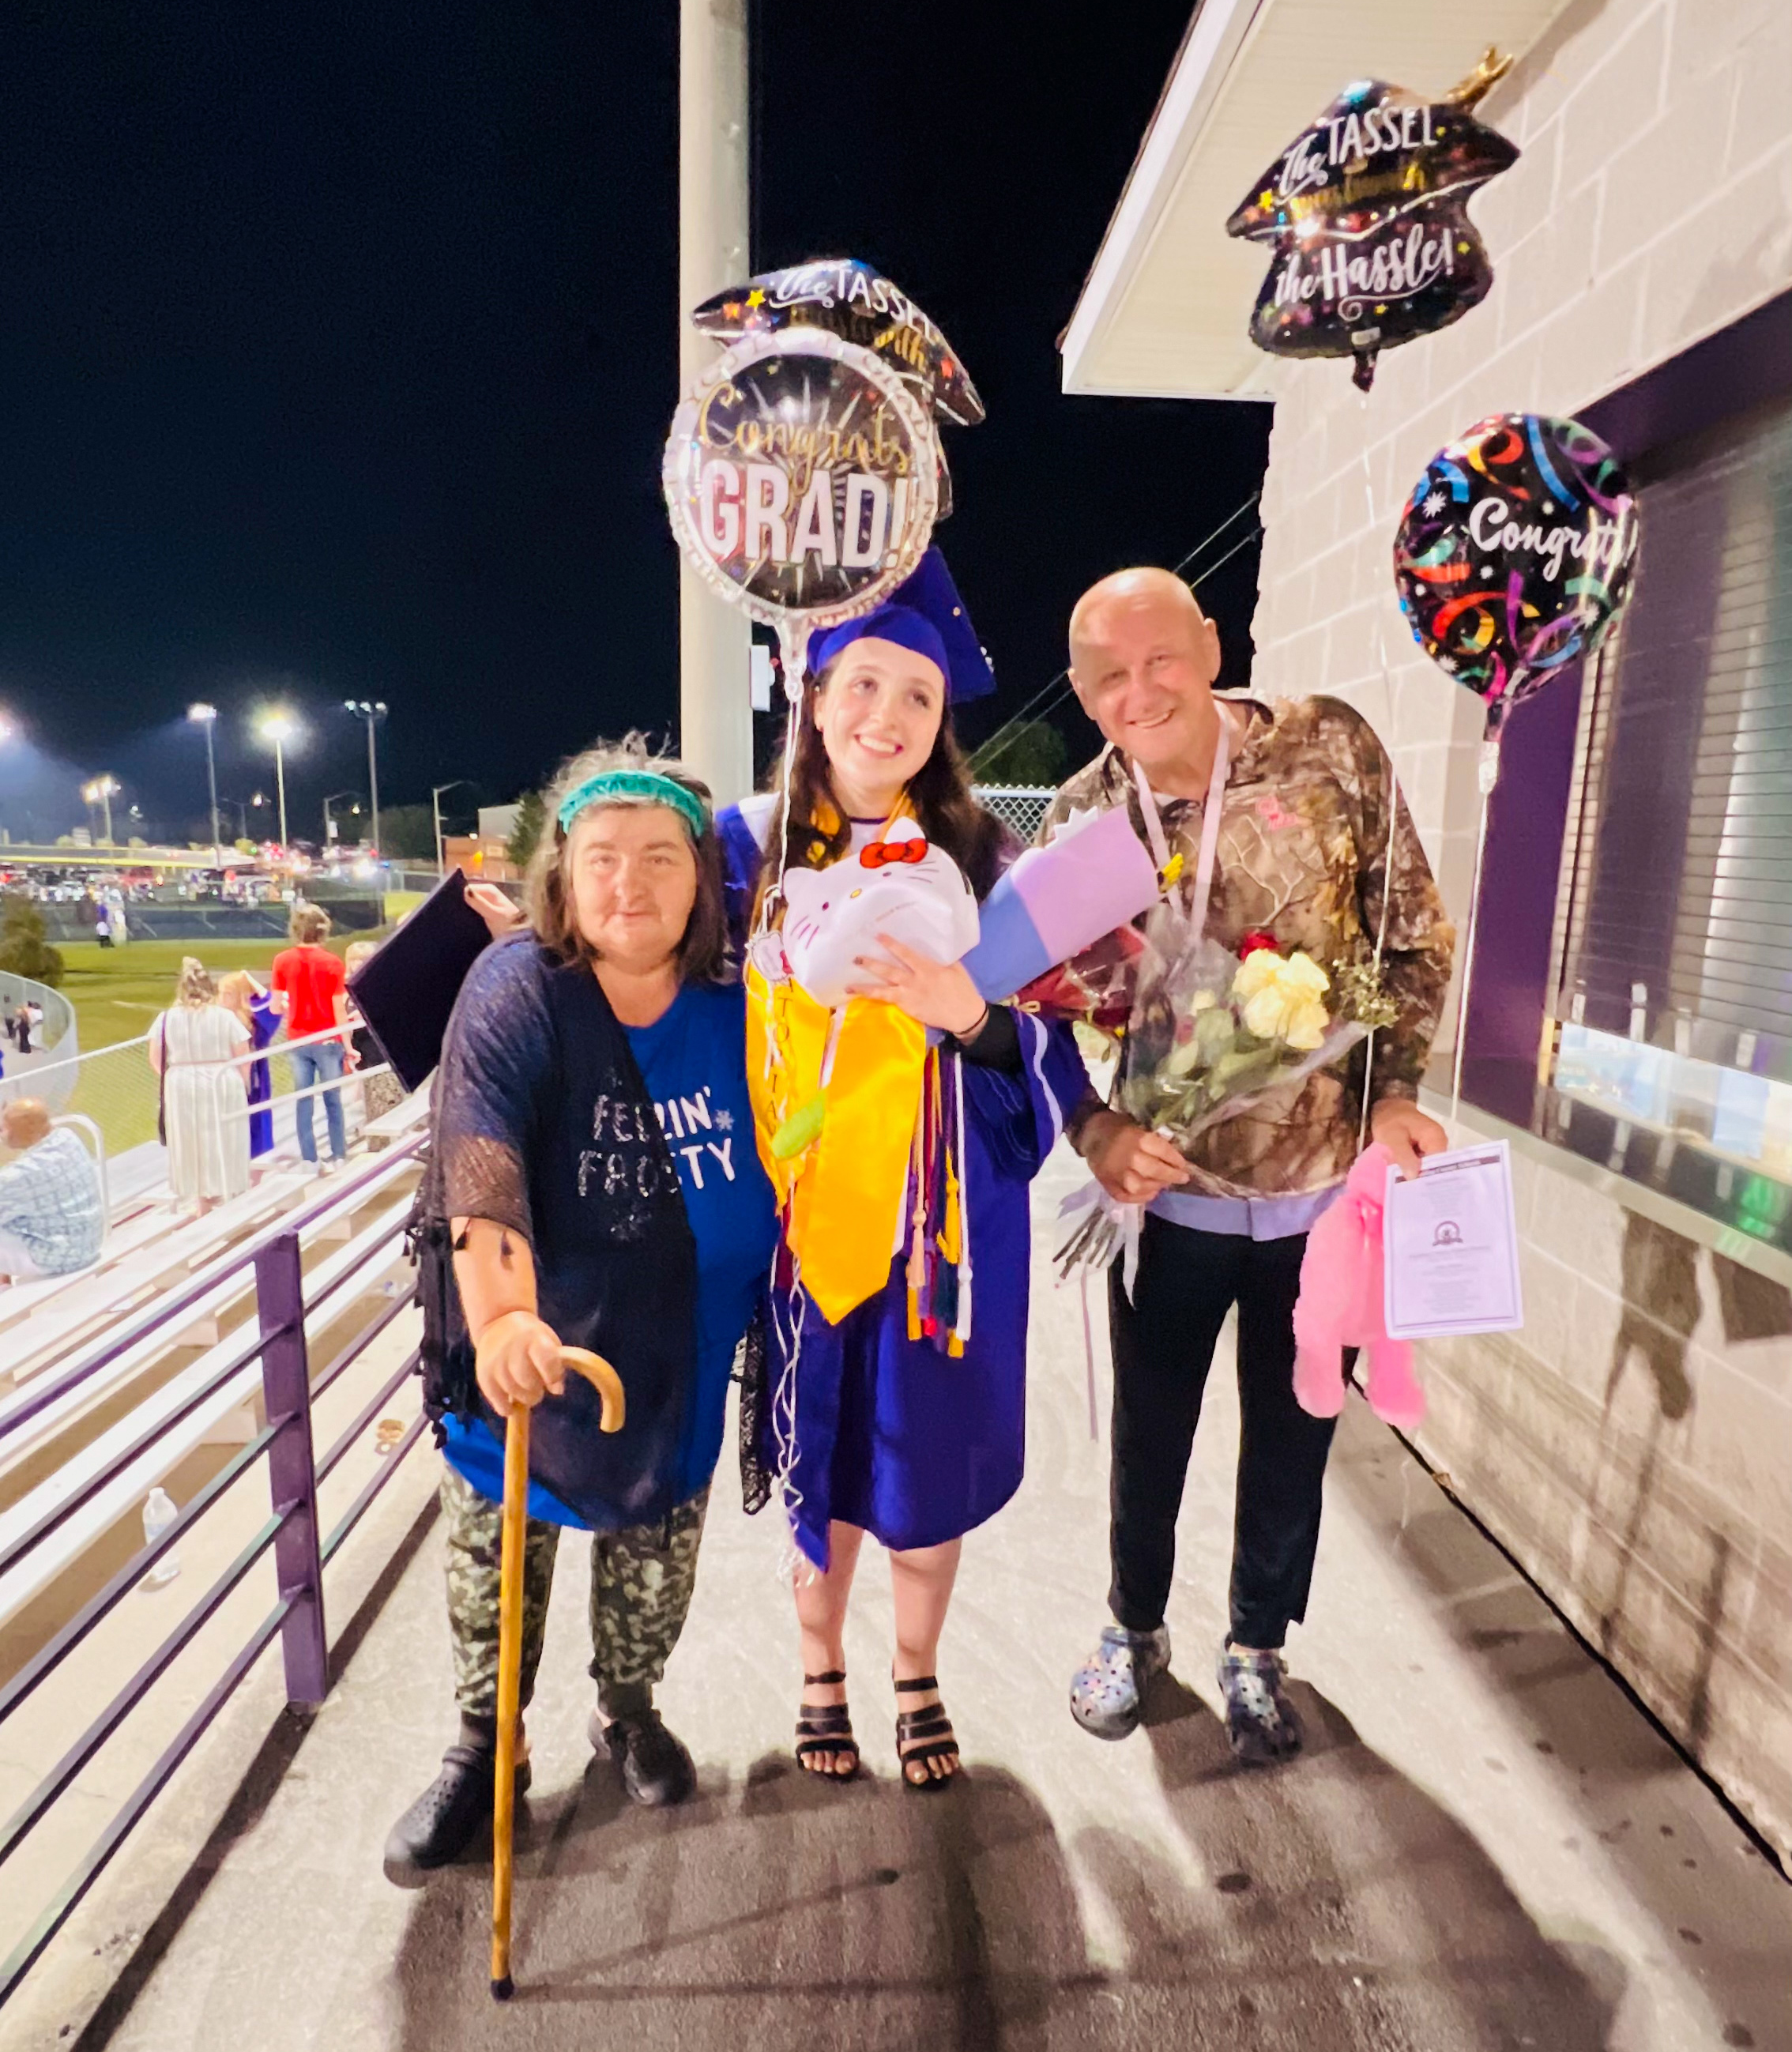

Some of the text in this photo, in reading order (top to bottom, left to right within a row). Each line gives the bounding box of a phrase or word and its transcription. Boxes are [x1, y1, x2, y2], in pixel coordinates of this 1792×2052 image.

[1274, 134, 1329, 205] The
[1326, 105, 1440, 166] TASSEL
[1274, 224, 1455, 308] the Hassle!
[698, 382, 911, 495] Congrats
[700, 459, 909, 569] GRAD!
[578, 1137, 736, 1198] FROTY
